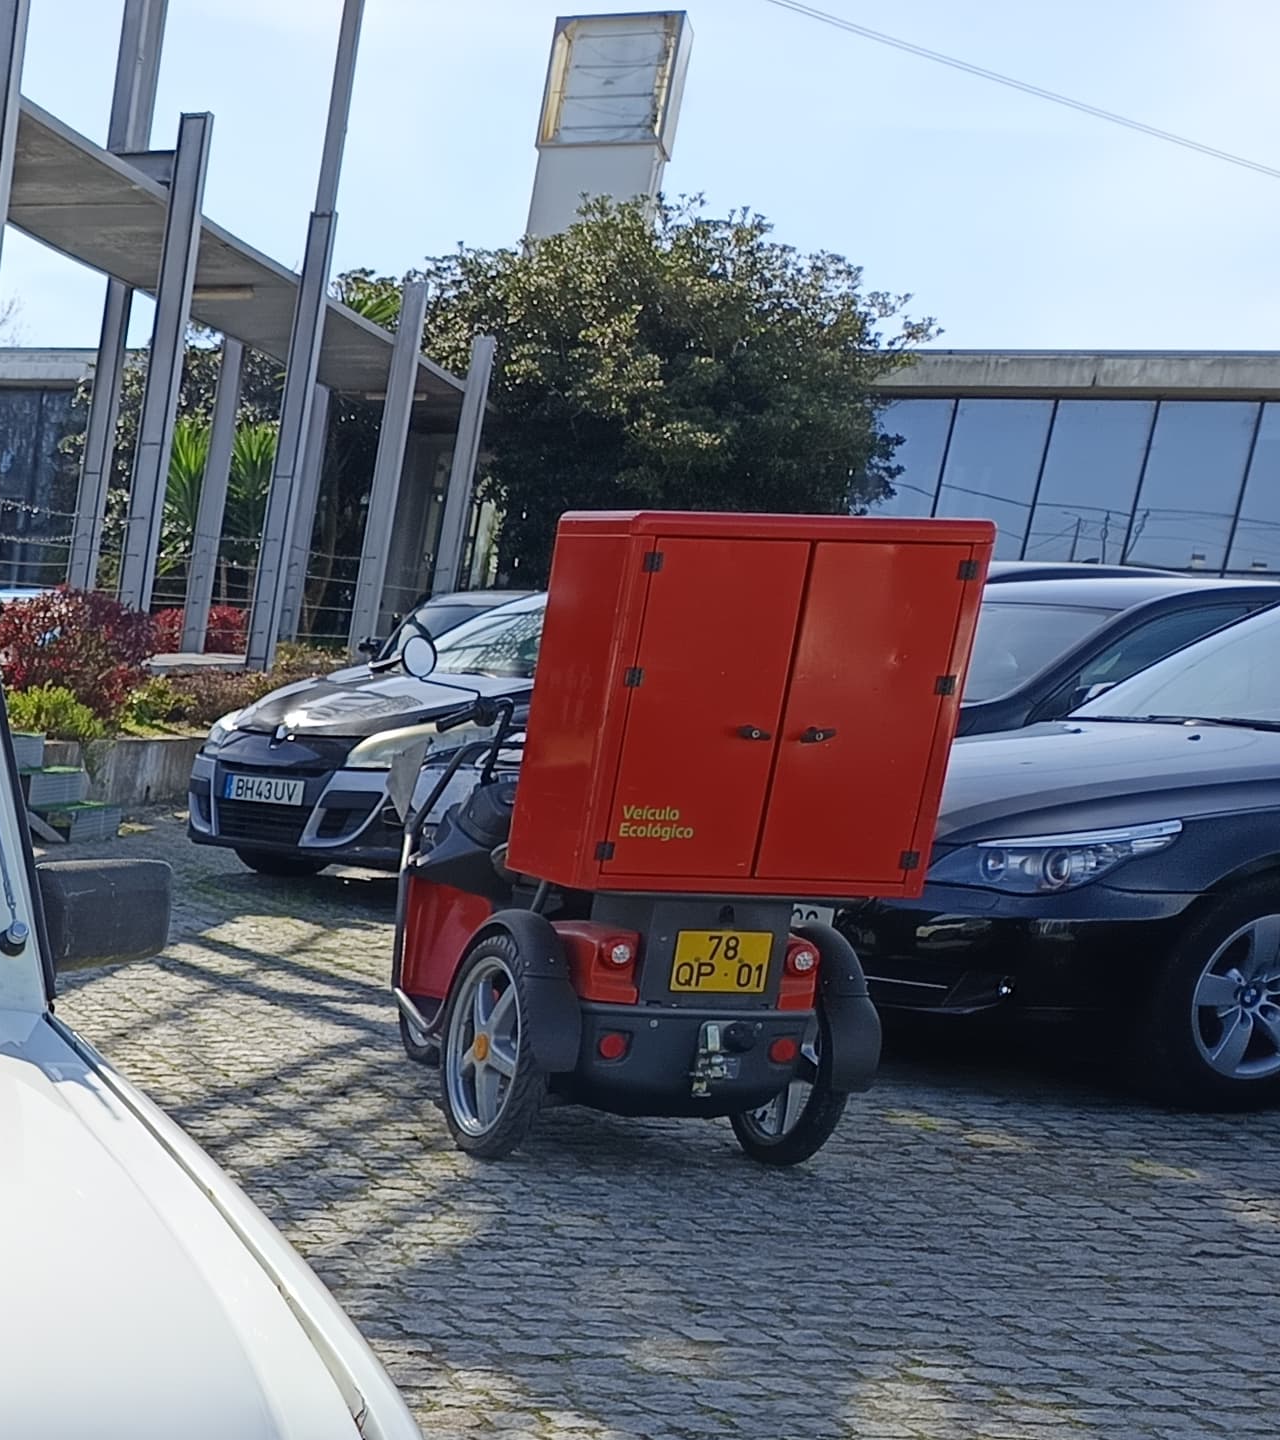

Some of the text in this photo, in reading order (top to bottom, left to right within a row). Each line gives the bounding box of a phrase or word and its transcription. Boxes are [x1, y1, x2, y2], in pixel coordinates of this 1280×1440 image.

[236, 778, 297, 802] BH43UV
[623, 805, 680, 821] Veículo
[619, 822, 694, 842] Ecológico
[708, 935, 740, 961] 78
